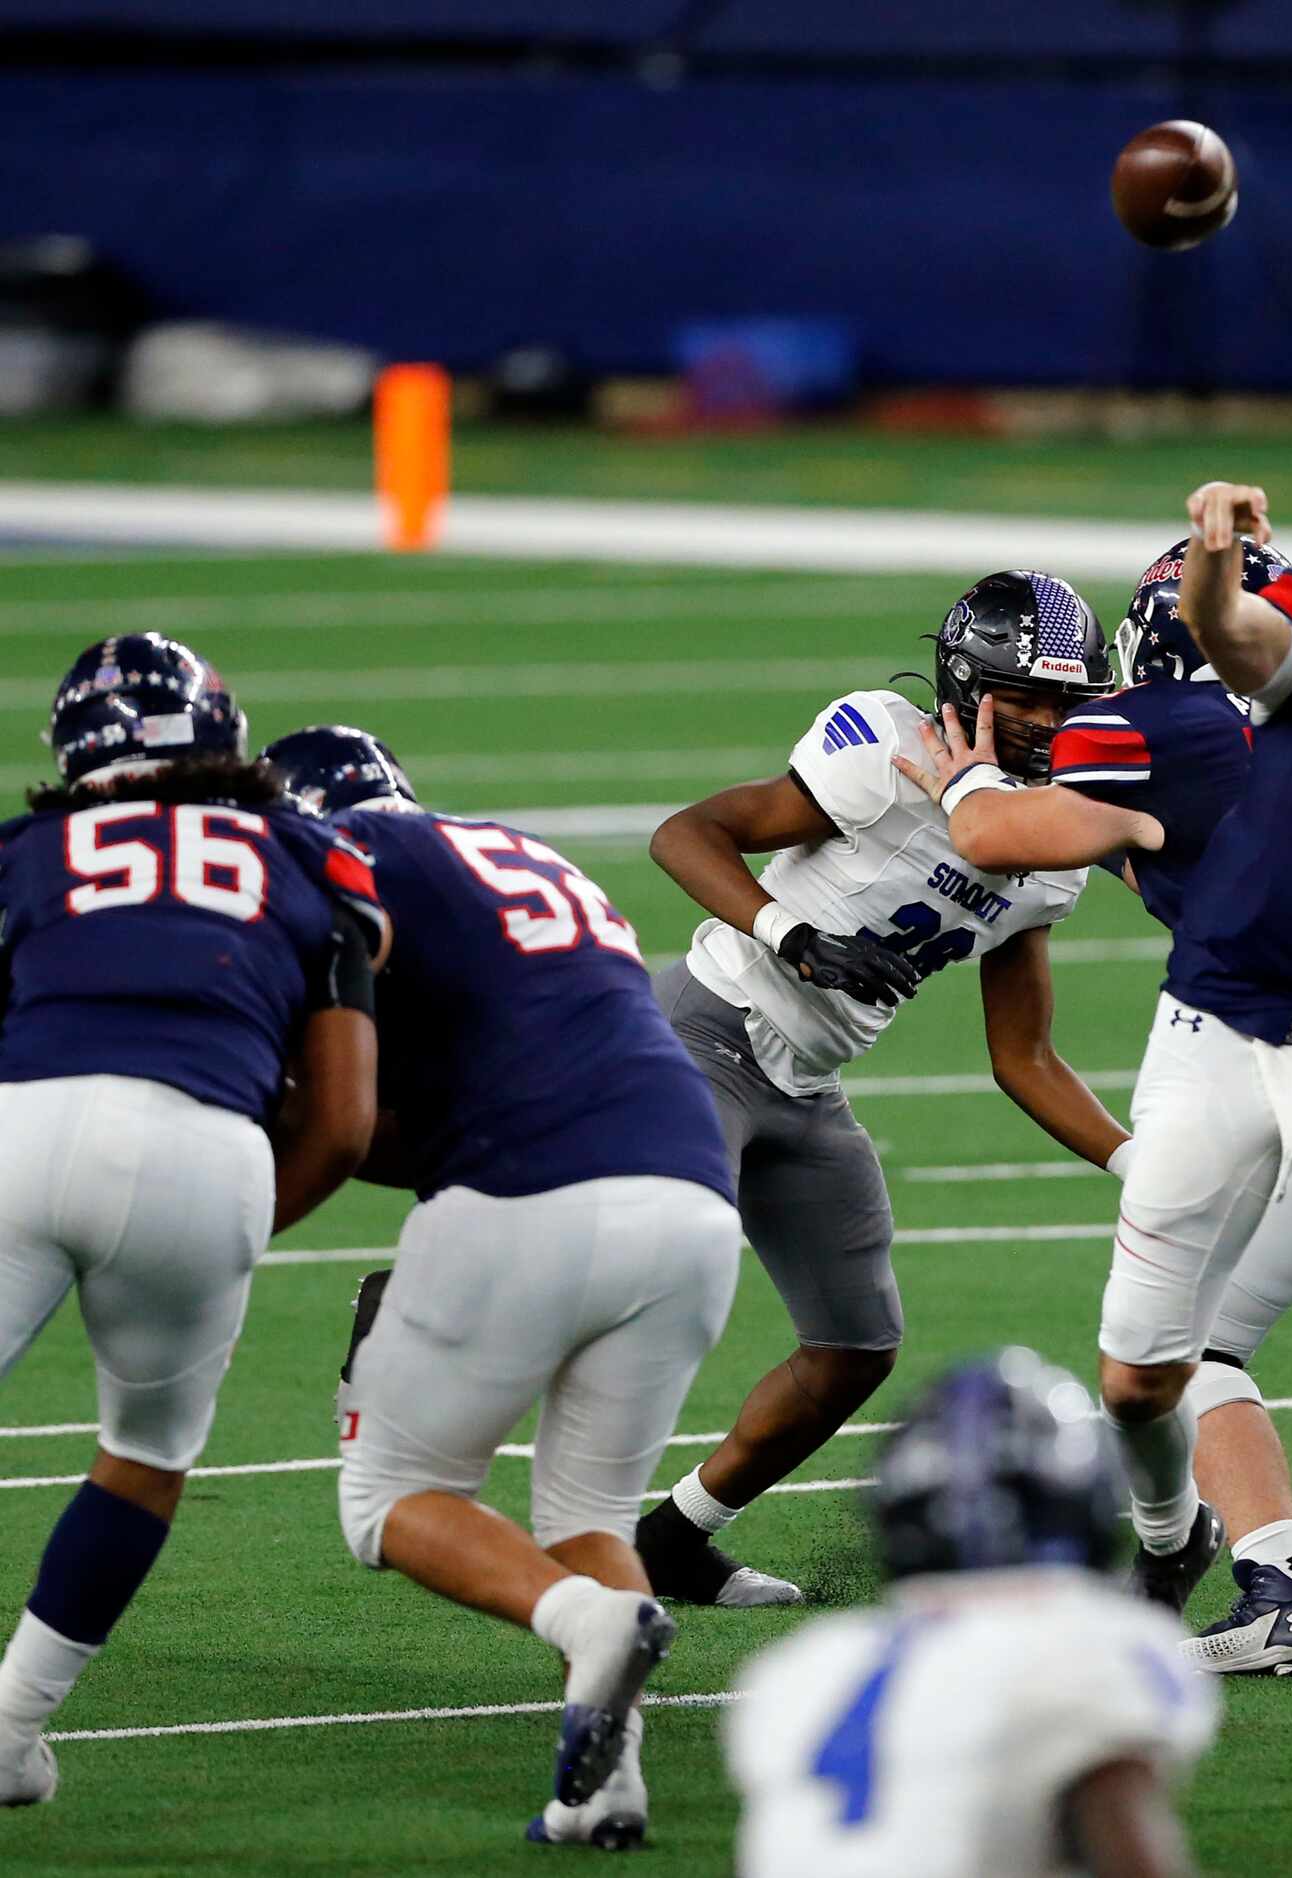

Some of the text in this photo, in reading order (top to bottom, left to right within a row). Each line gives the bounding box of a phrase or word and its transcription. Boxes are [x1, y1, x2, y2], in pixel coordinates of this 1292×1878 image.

[1041, 660, 1083, 673] Riddell
[64, 799, 270, 923] 56
[927, 861, 1013, 924] SUMMIT
